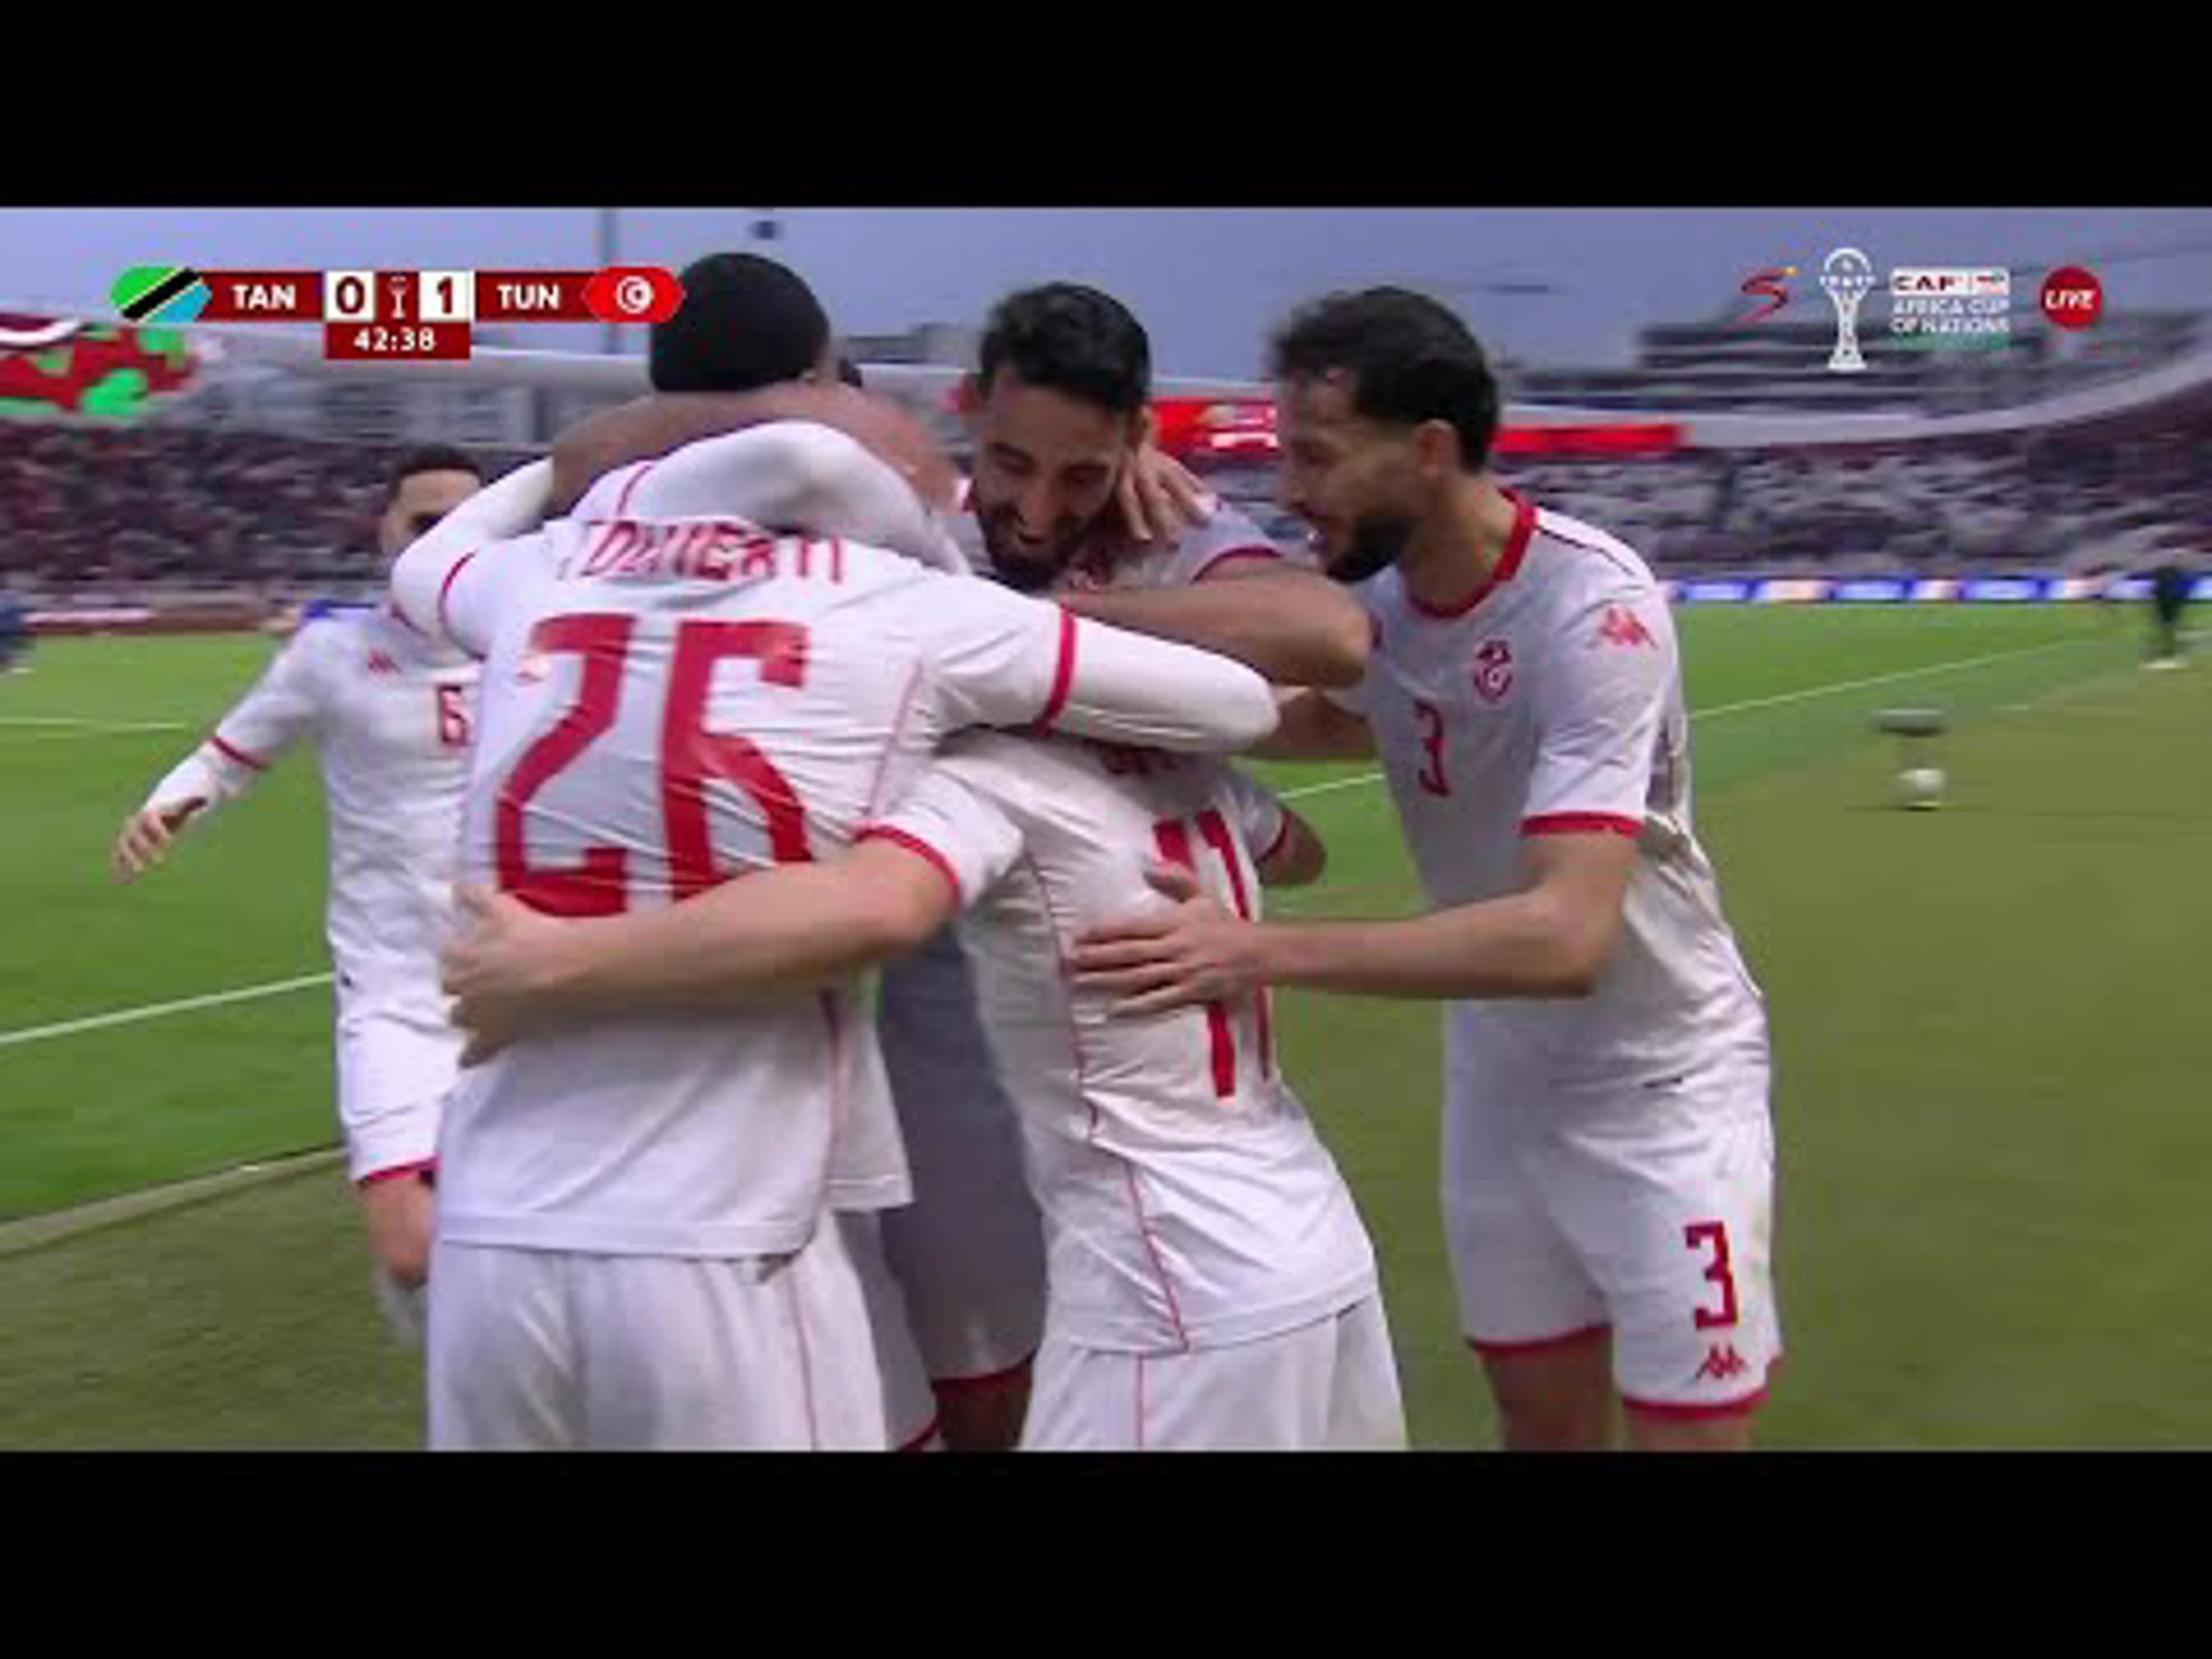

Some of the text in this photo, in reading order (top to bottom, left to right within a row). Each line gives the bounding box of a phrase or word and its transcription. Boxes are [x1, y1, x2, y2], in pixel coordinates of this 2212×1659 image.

[438, 683, 468, 747] 6
[497, 613, 814, 917] 26
[1414, 699, 1451, 797] 3
[1684, 1221, 1738, 1331] 3
